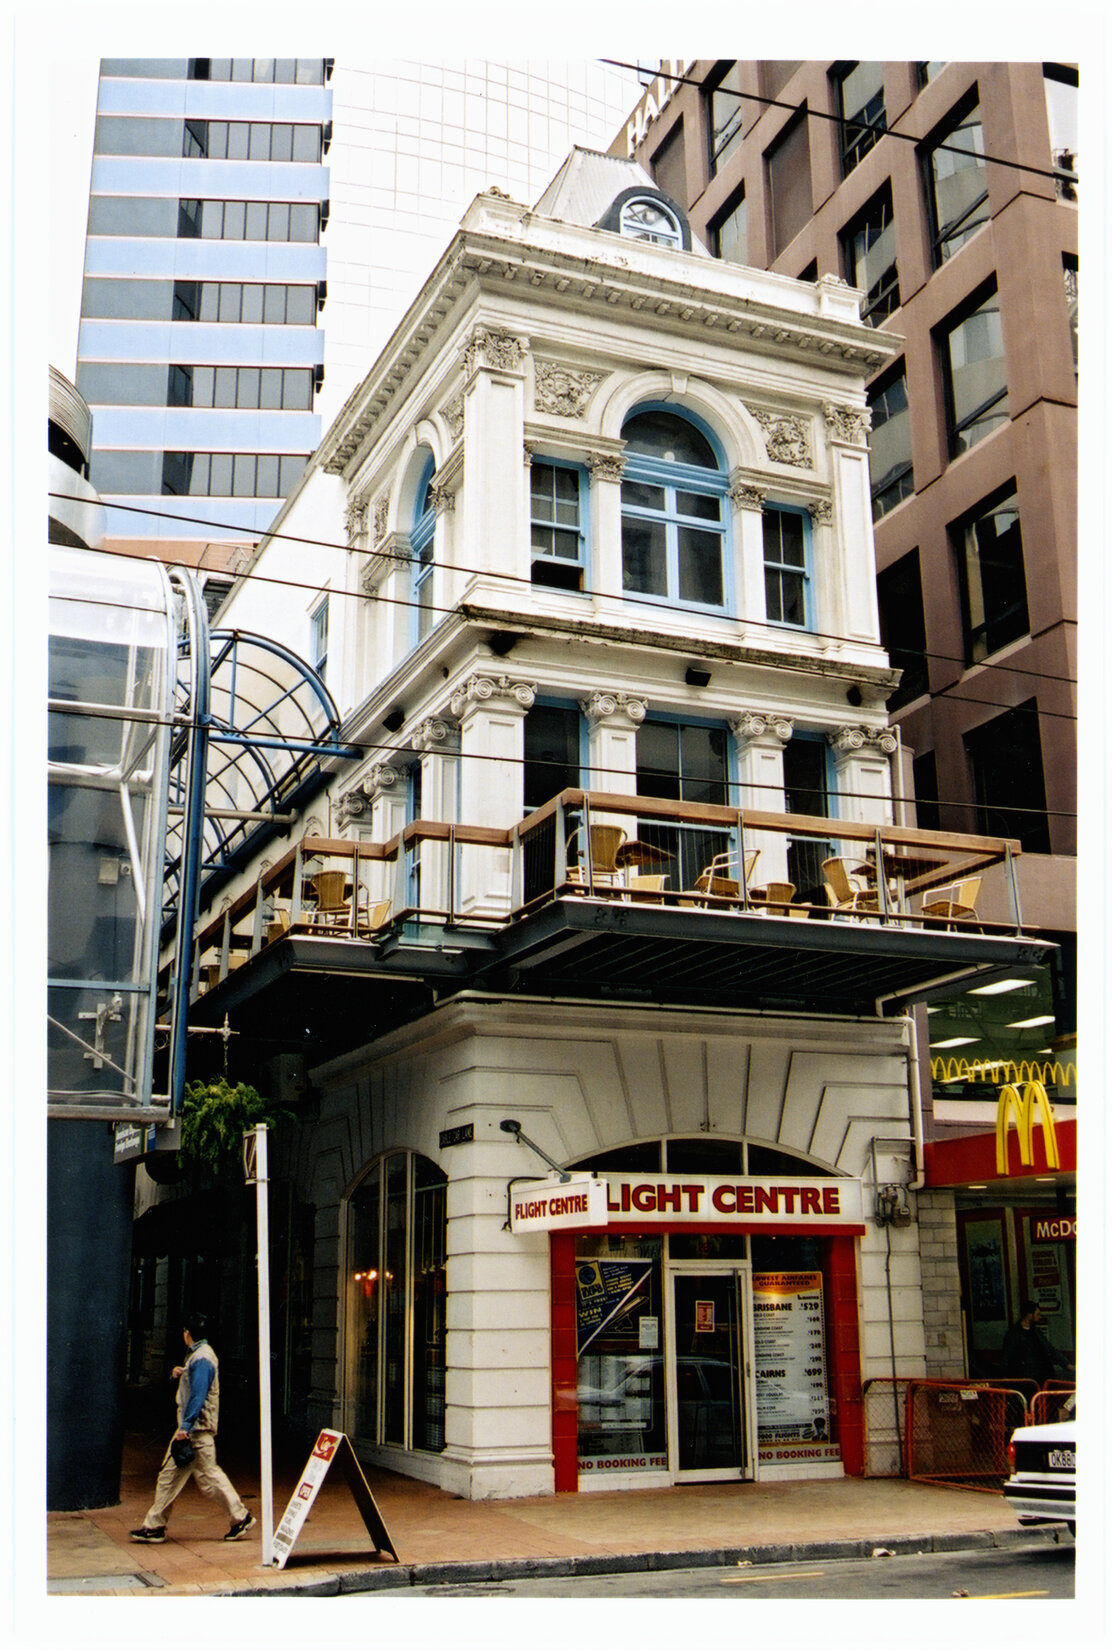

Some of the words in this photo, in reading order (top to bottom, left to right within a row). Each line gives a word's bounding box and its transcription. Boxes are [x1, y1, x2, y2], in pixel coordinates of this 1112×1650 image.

[712, 1185, 840, 1214] CENTRE
[515, 1199, 547, 1220] FLIGHT
[549, 1193, 588, 1216] CENTRE
[753, 1303, 793, 1312] BRISBANE
[756, 1369, 785, 1378] CAIRNS
[759, 1449, 773, 1459] NO
[776, 1447, 823, 1459] BOOKING
[825, 1446, 840, 1457] FEE
[578, 1460, 594, 1470] NO
[597, 1457, 647, 1469] BOOKING
[649, 1456, 667, 1466] FEE
